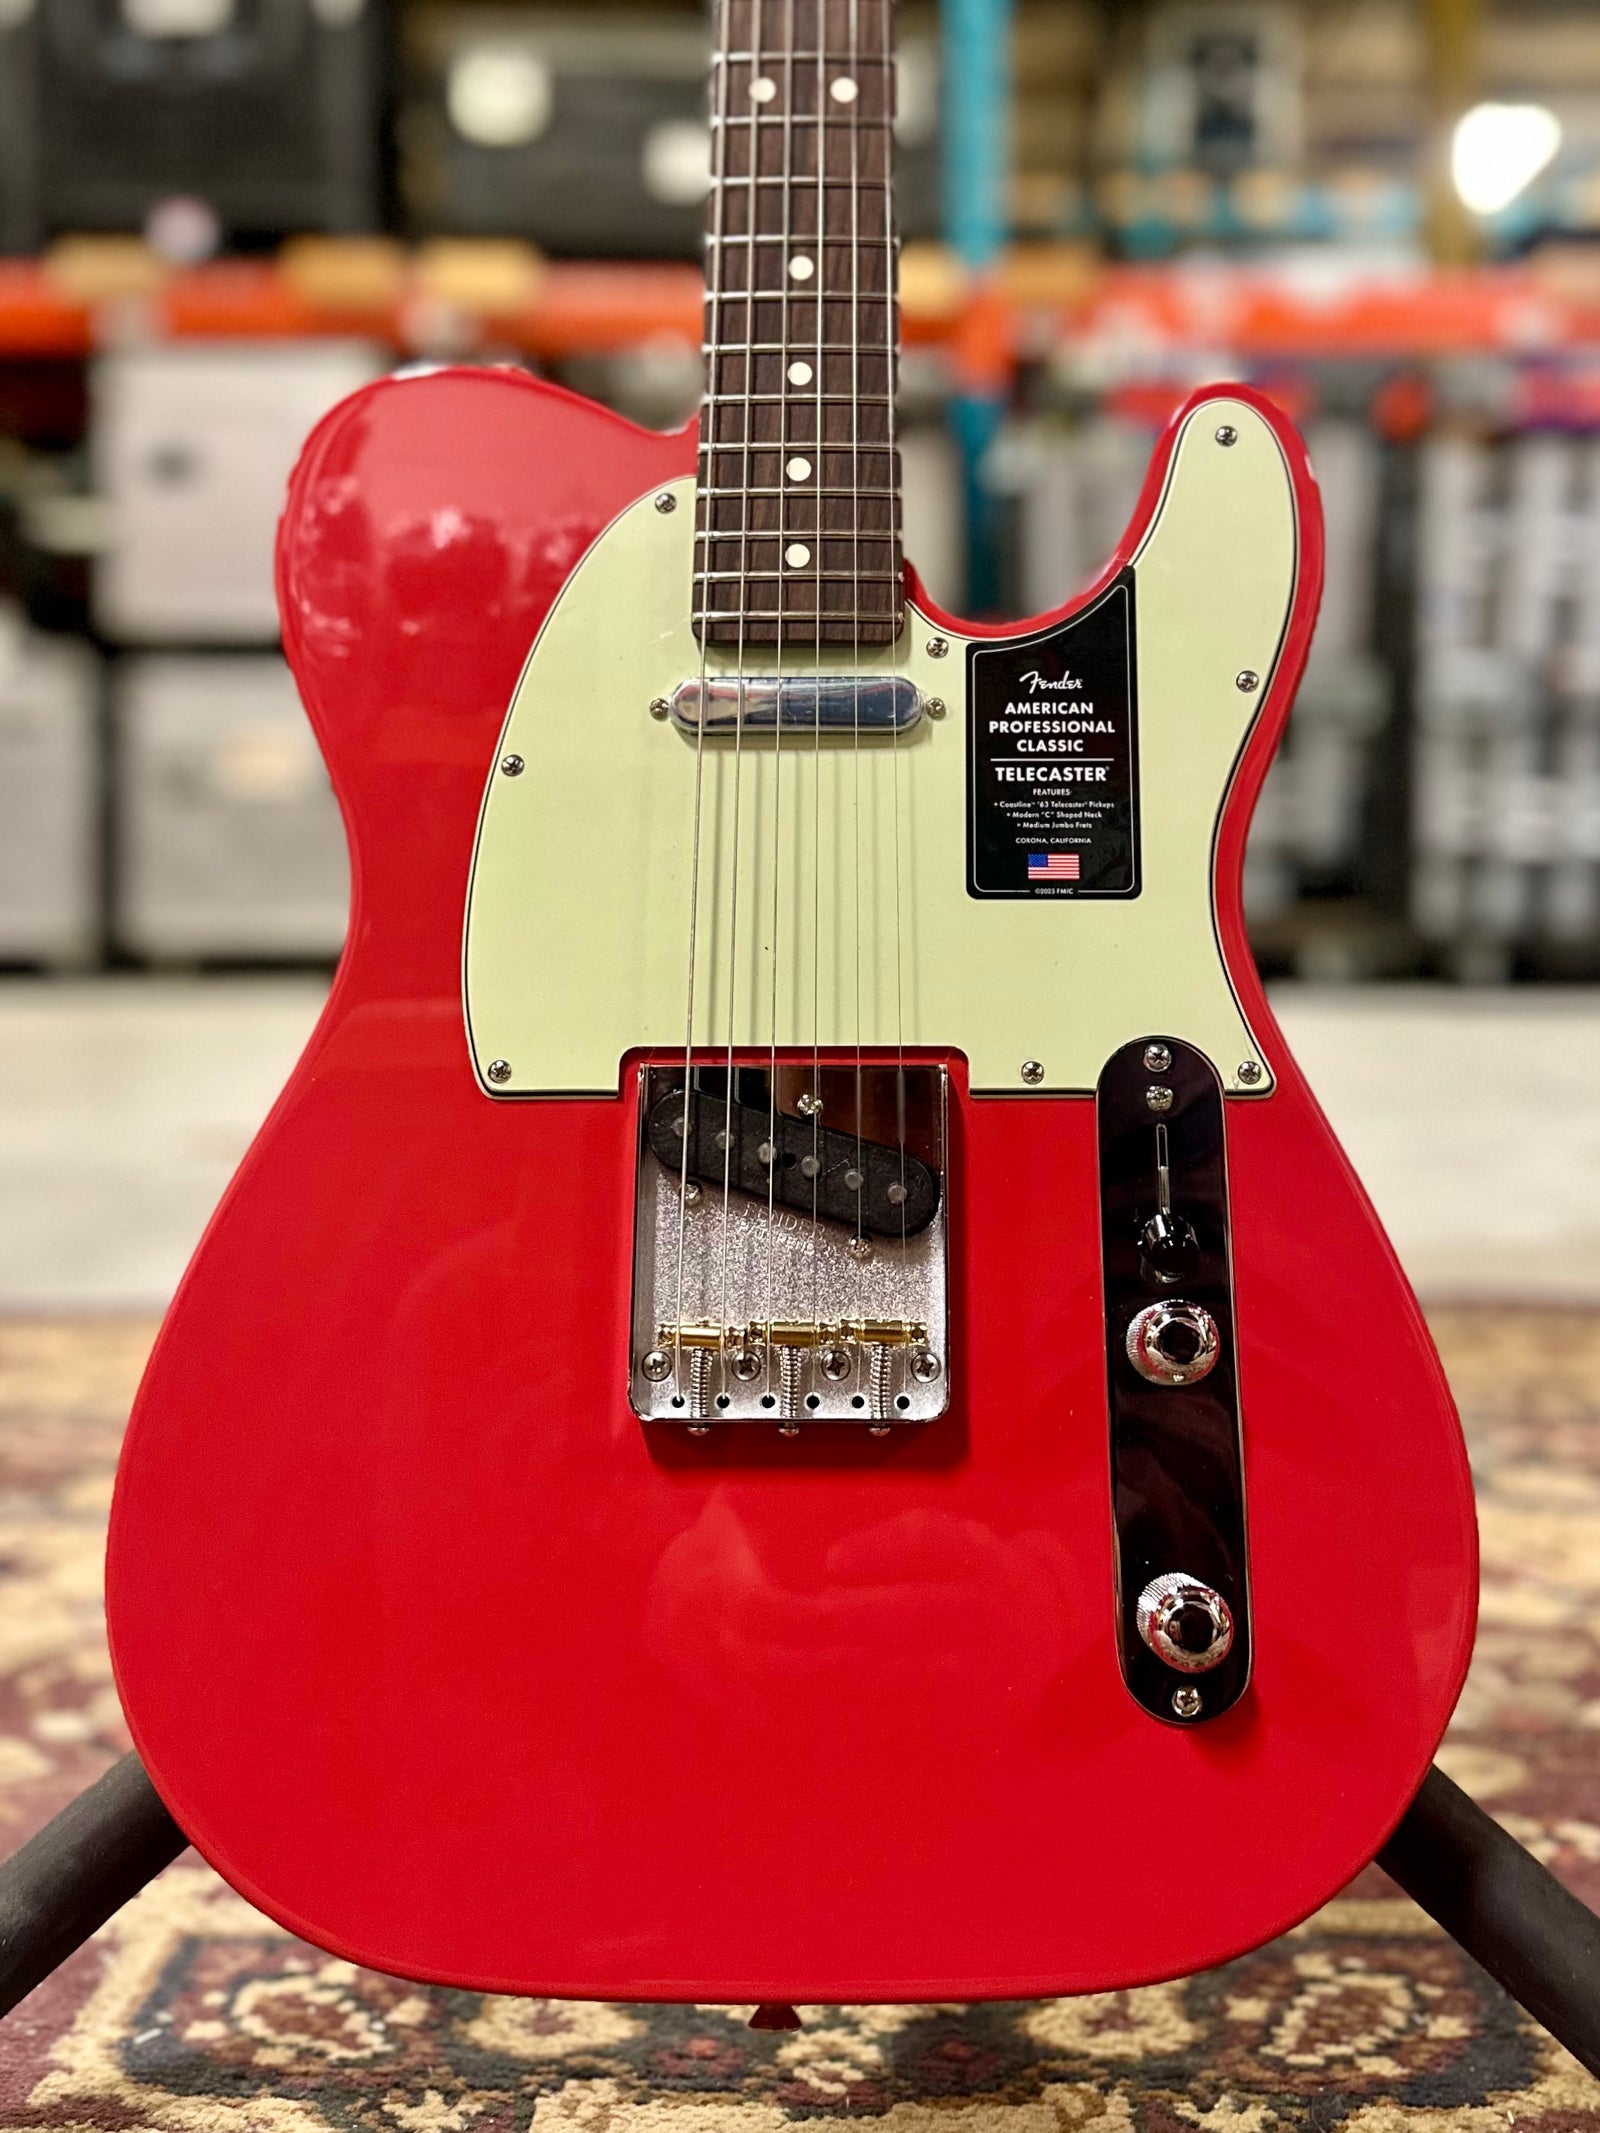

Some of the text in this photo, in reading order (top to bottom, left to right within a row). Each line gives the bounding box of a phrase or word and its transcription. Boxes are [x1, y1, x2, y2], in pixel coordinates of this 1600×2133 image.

[1019, 670, 1083, 694] Fender
[1004, 702, 1093, 715] AMERICAN
[989, 720, 1116, 733] PROFESSIONAL
[1016, 739, 1084, 752] CLASSIC
[1056, 811, 1083, 819] Shaped
[1022, 821, 1093, 829] Medium Jumbo Frets
[742, 1202, 825, 1240] FENDER
